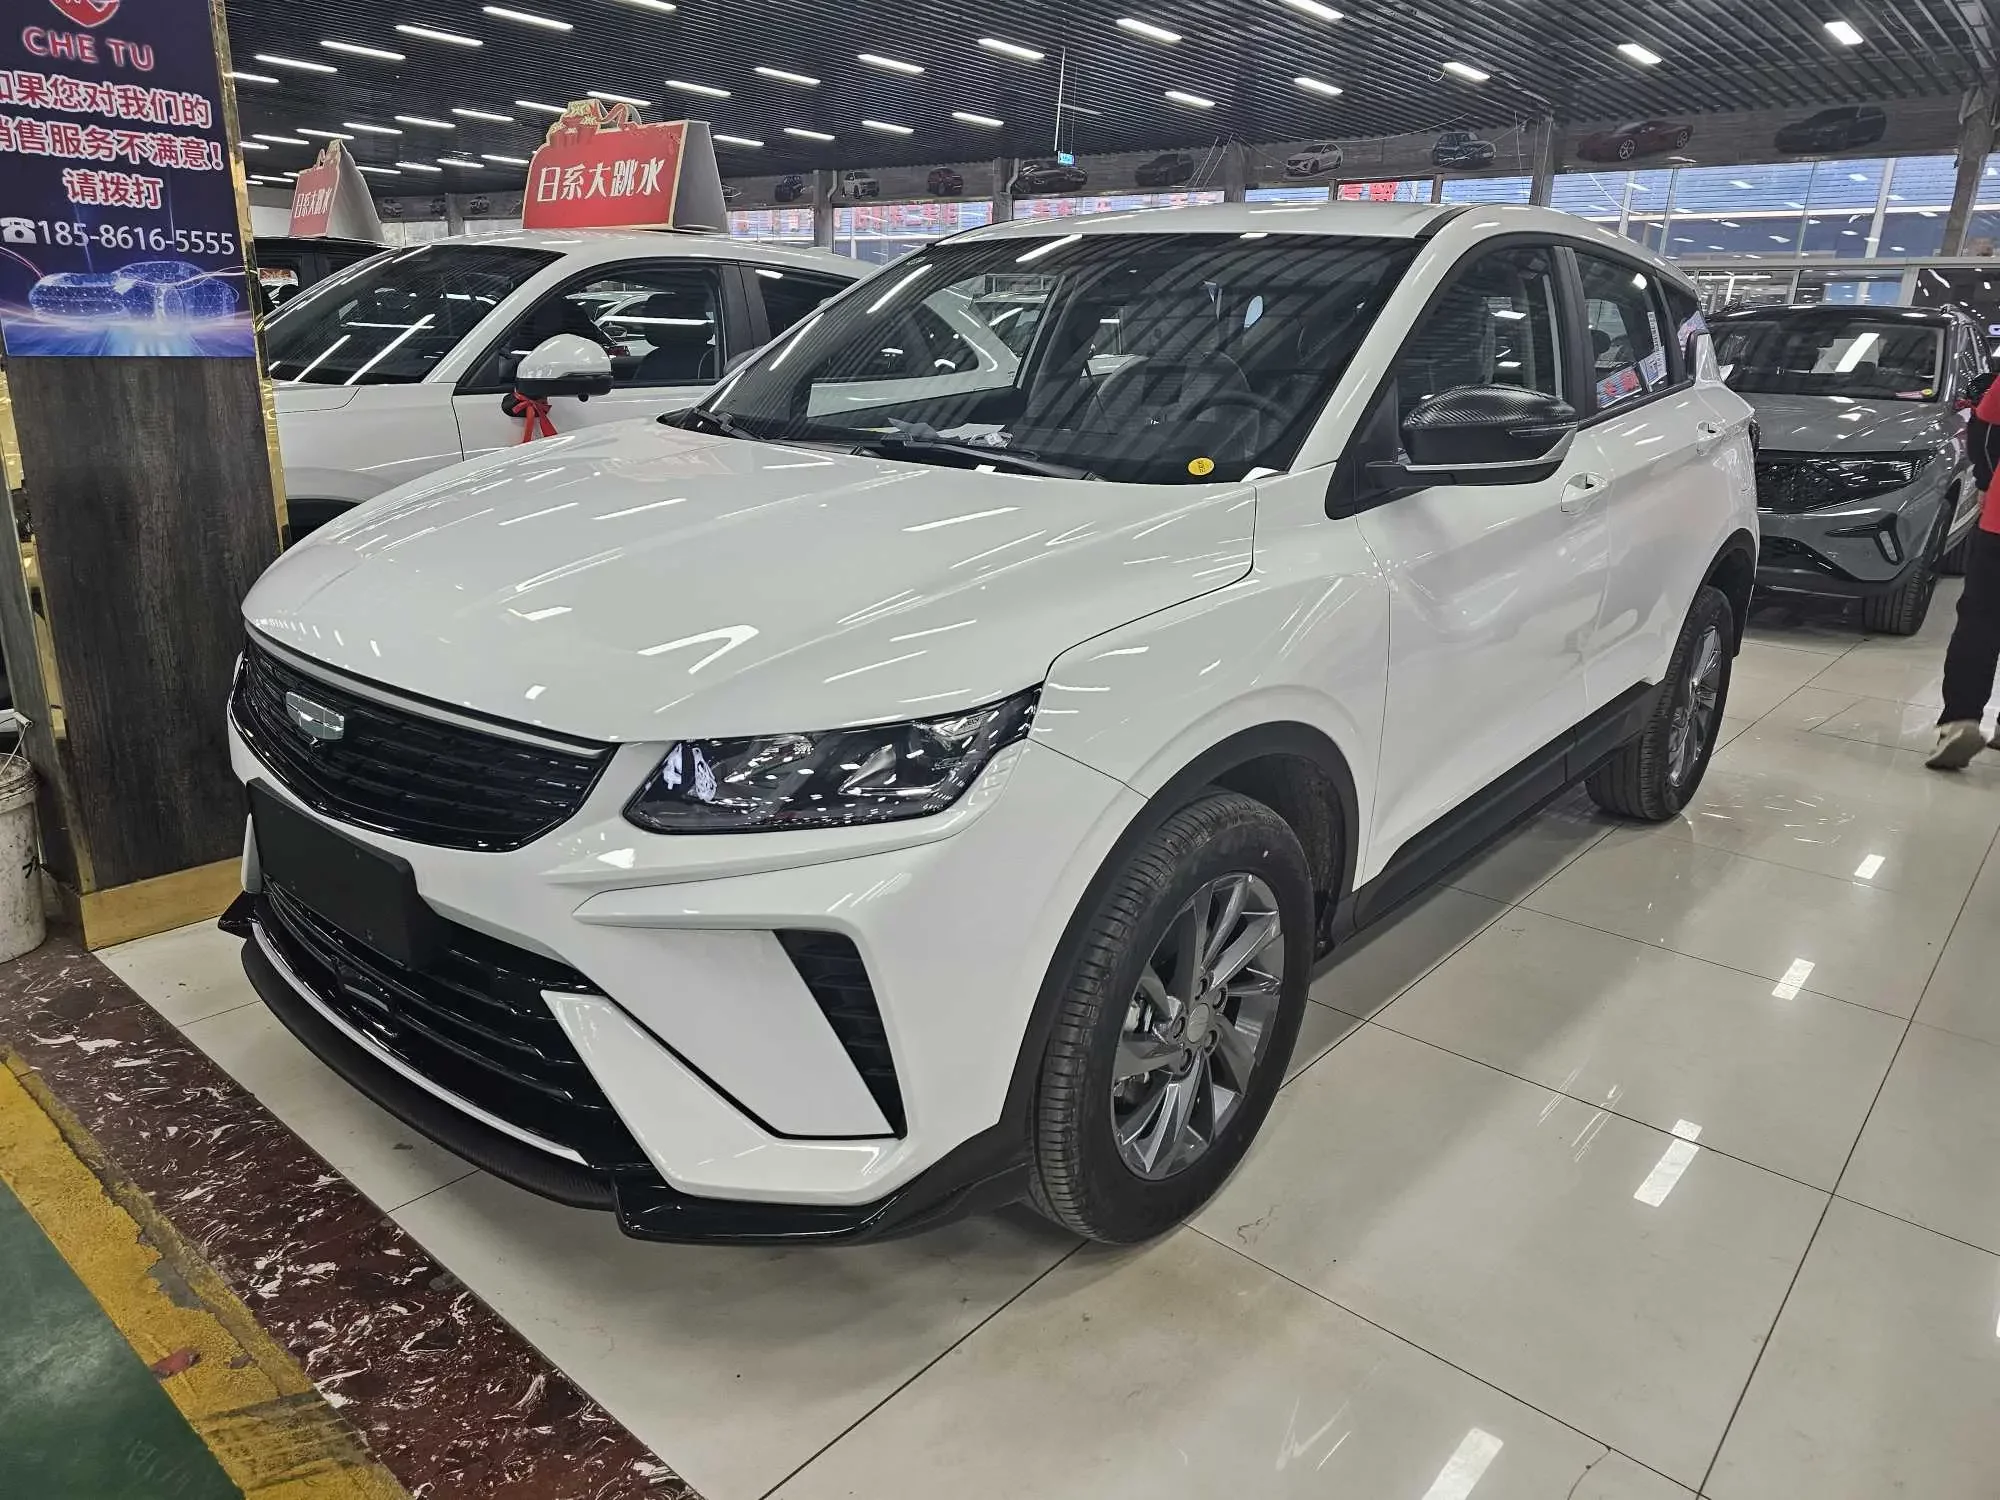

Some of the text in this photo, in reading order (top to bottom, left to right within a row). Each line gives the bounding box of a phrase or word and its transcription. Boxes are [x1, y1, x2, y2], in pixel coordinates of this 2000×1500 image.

[22, 26, 154, 71] CHE TU
[62, 168, 164, 209] 请拨打
[537, 157, 665, 202] 日系大跳水
[294, 187, 333, 218] 日系大跳水
[38, 220, 235, 256] 185-8616-5555
